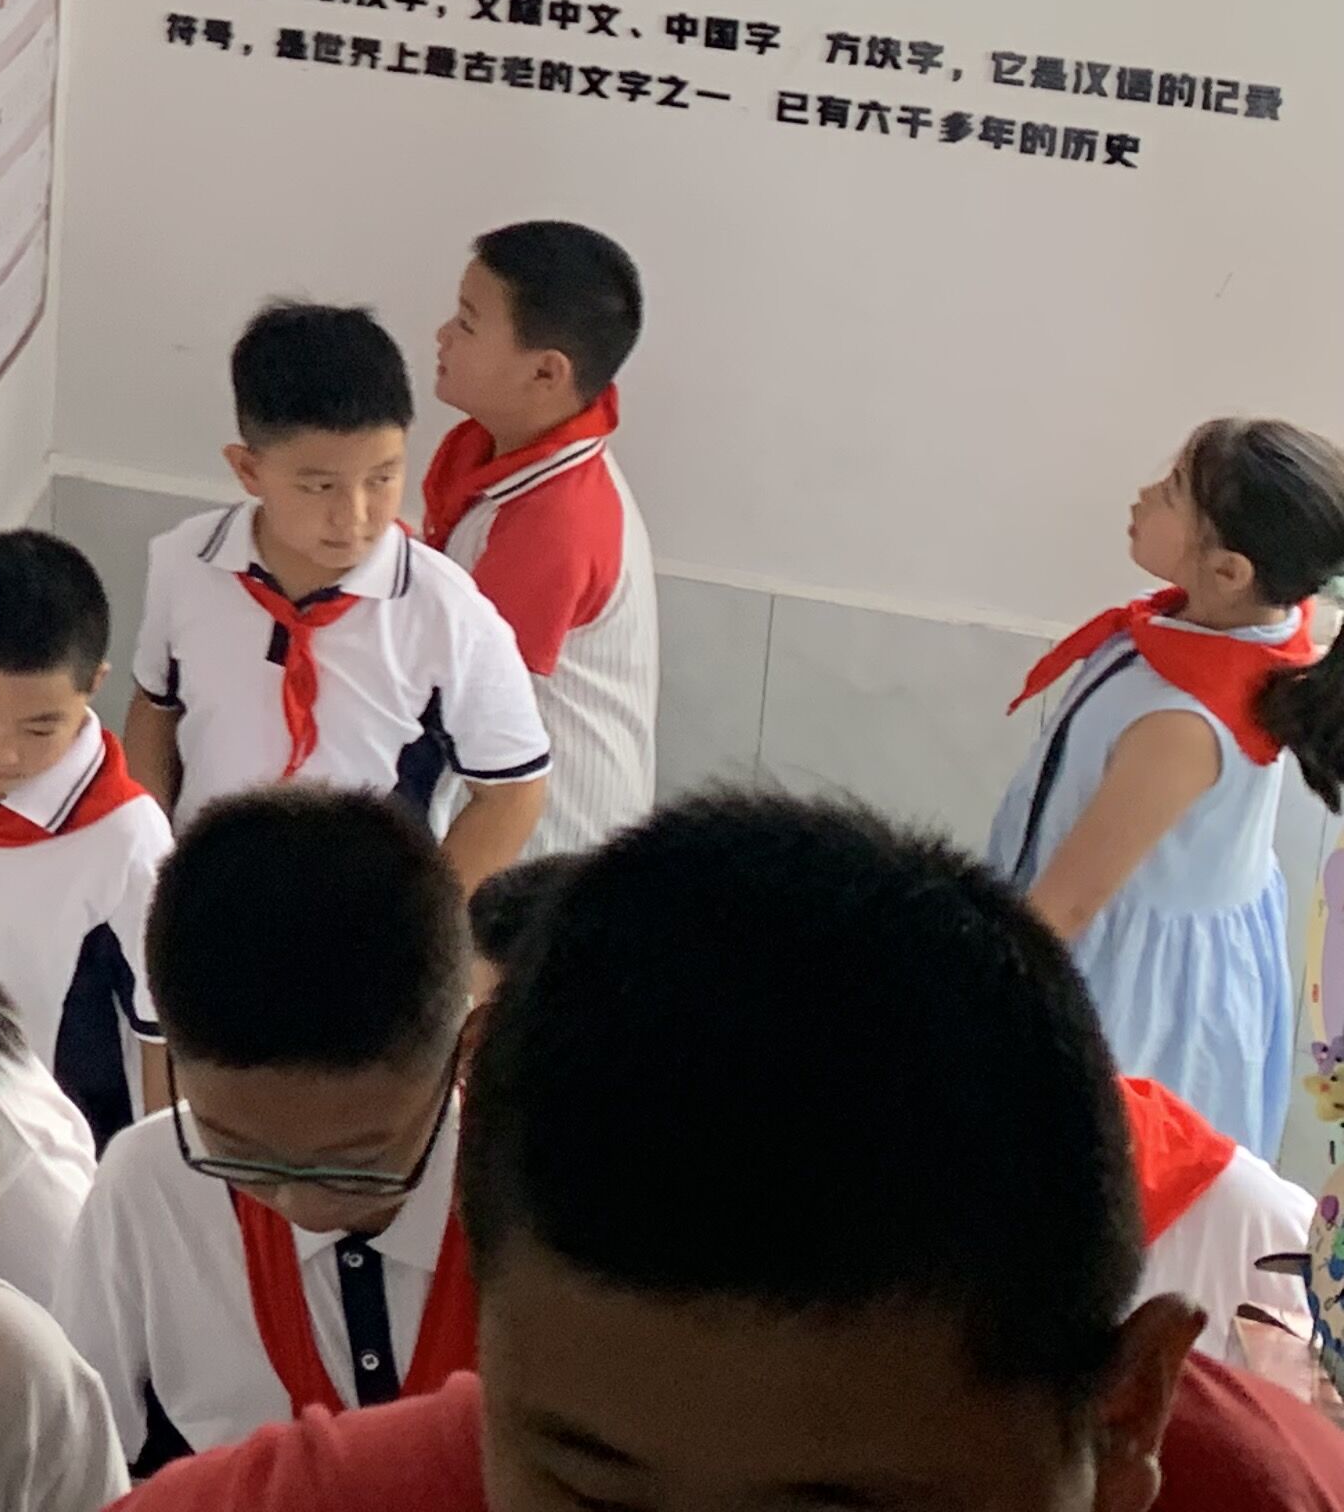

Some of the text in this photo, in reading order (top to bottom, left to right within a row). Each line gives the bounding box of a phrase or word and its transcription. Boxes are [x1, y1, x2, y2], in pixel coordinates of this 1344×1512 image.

[775, 90, 1142, 169] 已有六千多年的历史
